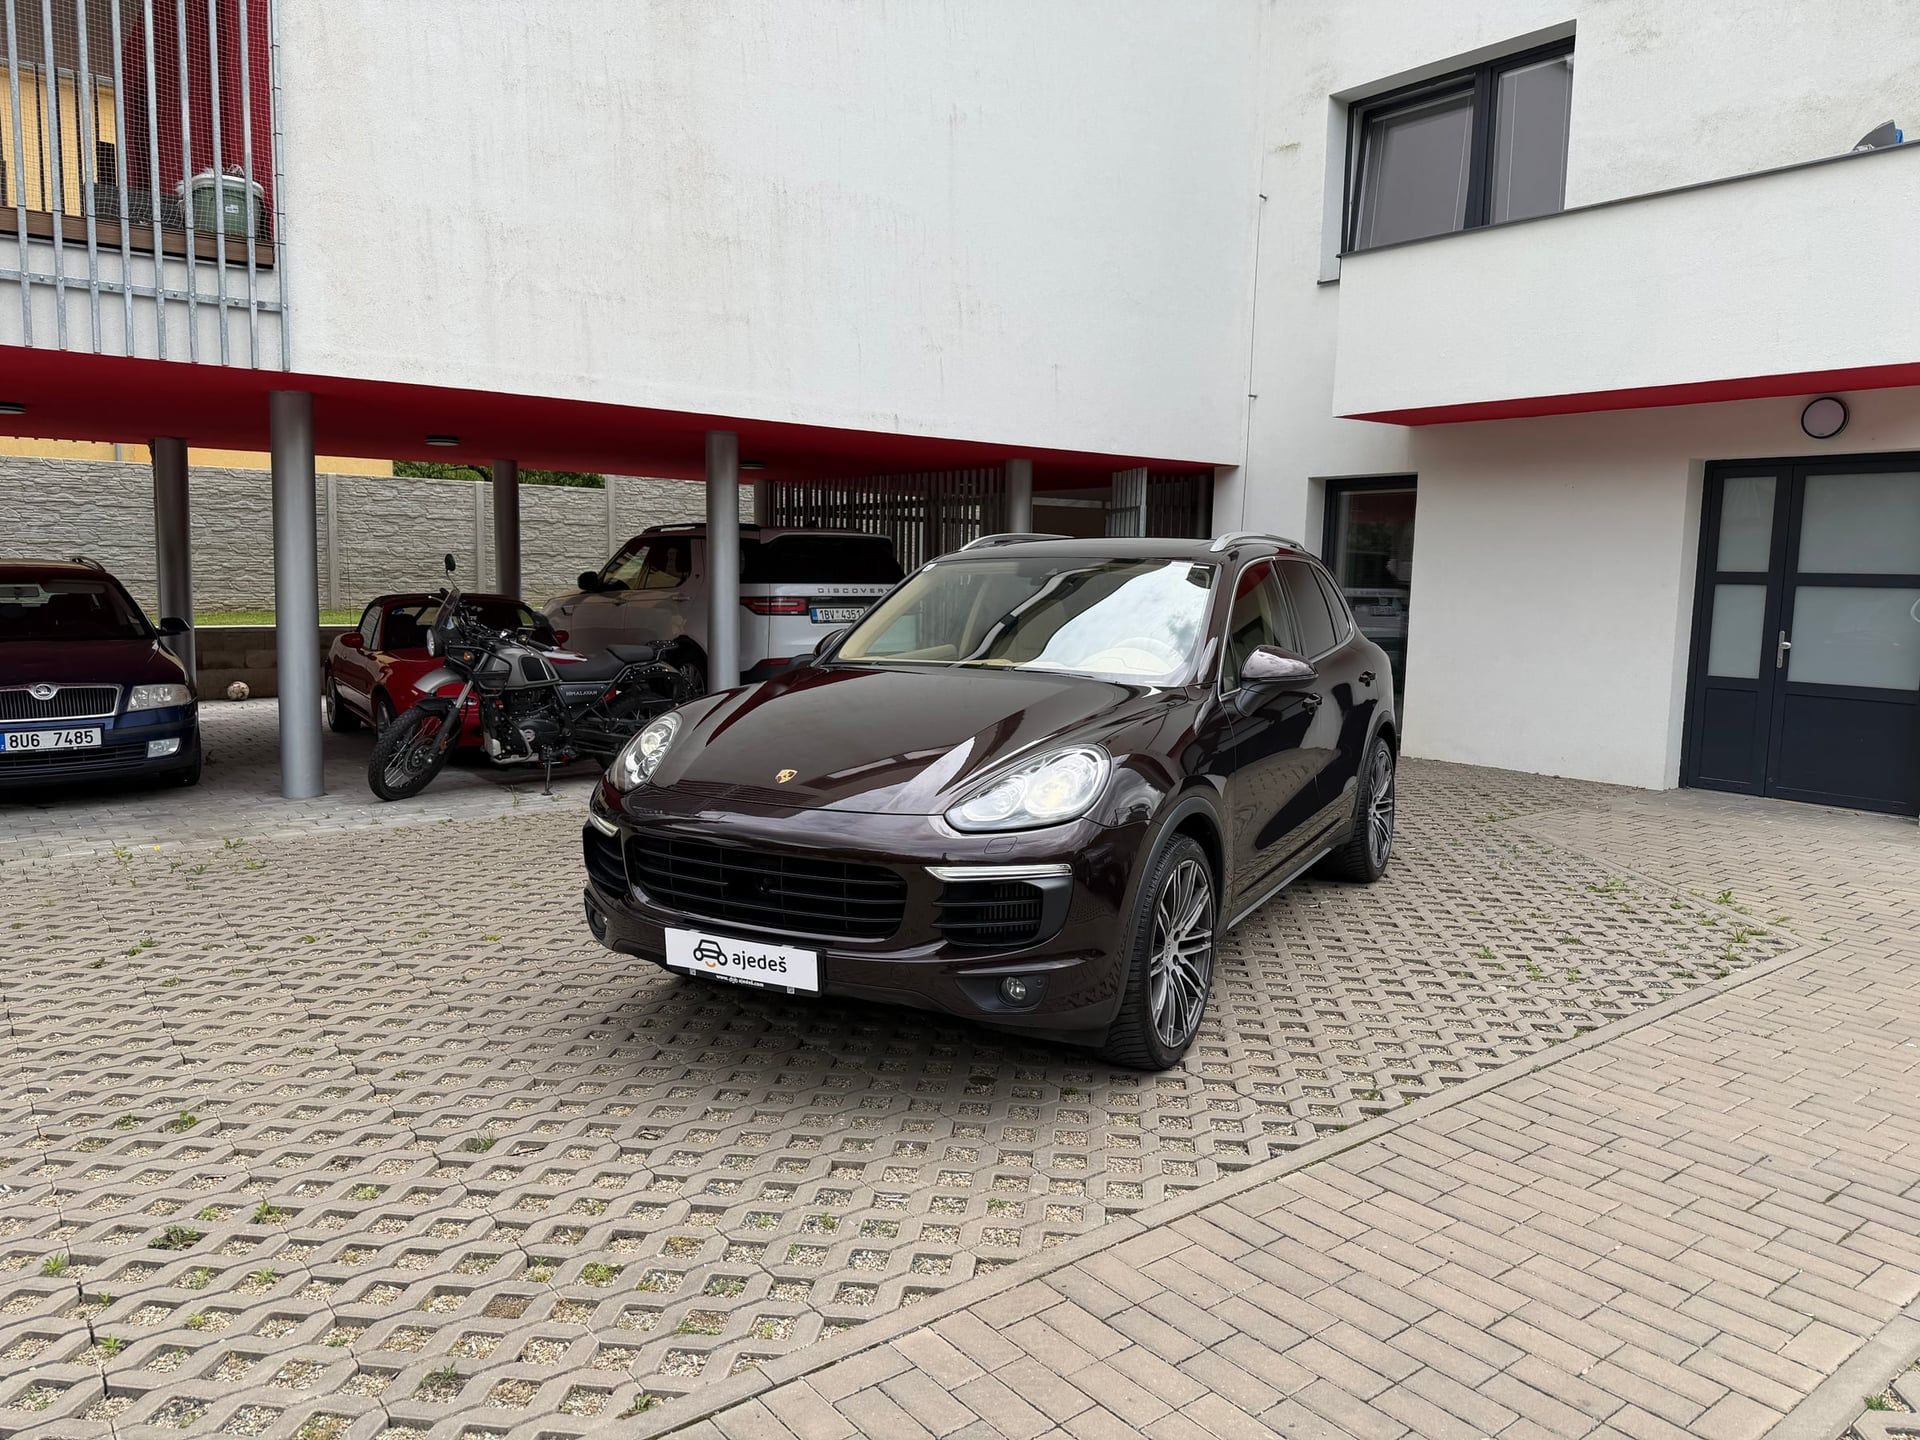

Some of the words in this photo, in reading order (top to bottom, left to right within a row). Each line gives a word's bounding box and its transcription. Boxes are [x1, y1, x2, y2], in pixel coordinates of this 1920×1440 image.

[820, 609, 835, 620] 1BV
[9, 733, 40, 748] 8U6
[53, 730, 94, 746] 7485
[732, 950, 787, 973] ajedeš
